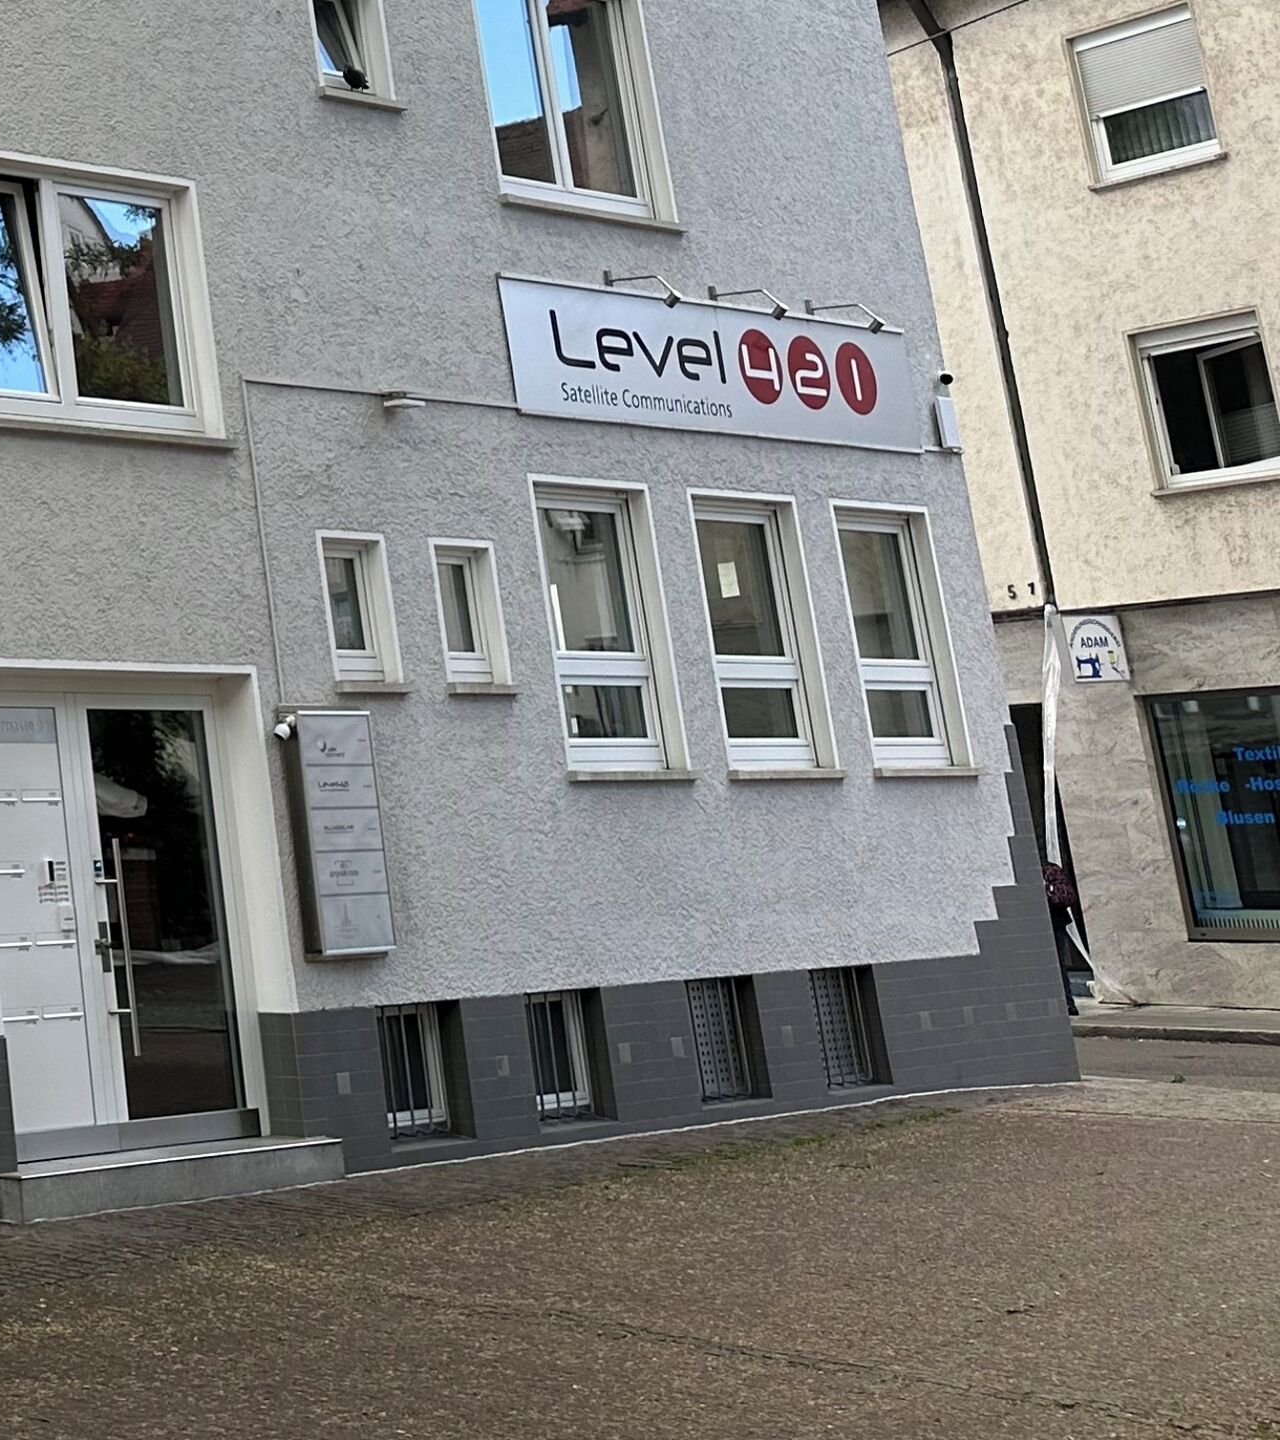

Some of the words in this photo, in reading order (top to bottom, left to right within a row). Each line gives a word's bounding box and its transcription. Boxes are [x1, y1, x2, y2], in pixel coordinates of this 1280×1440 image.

[549, 309, 727, 384] Level
[561, 382, 618, 406] Satellite
[622, 389, 733, 418] Communications
[1080, 636, 1109, 648] ADAM
[1216, 810, 1275, 825] Blusen
